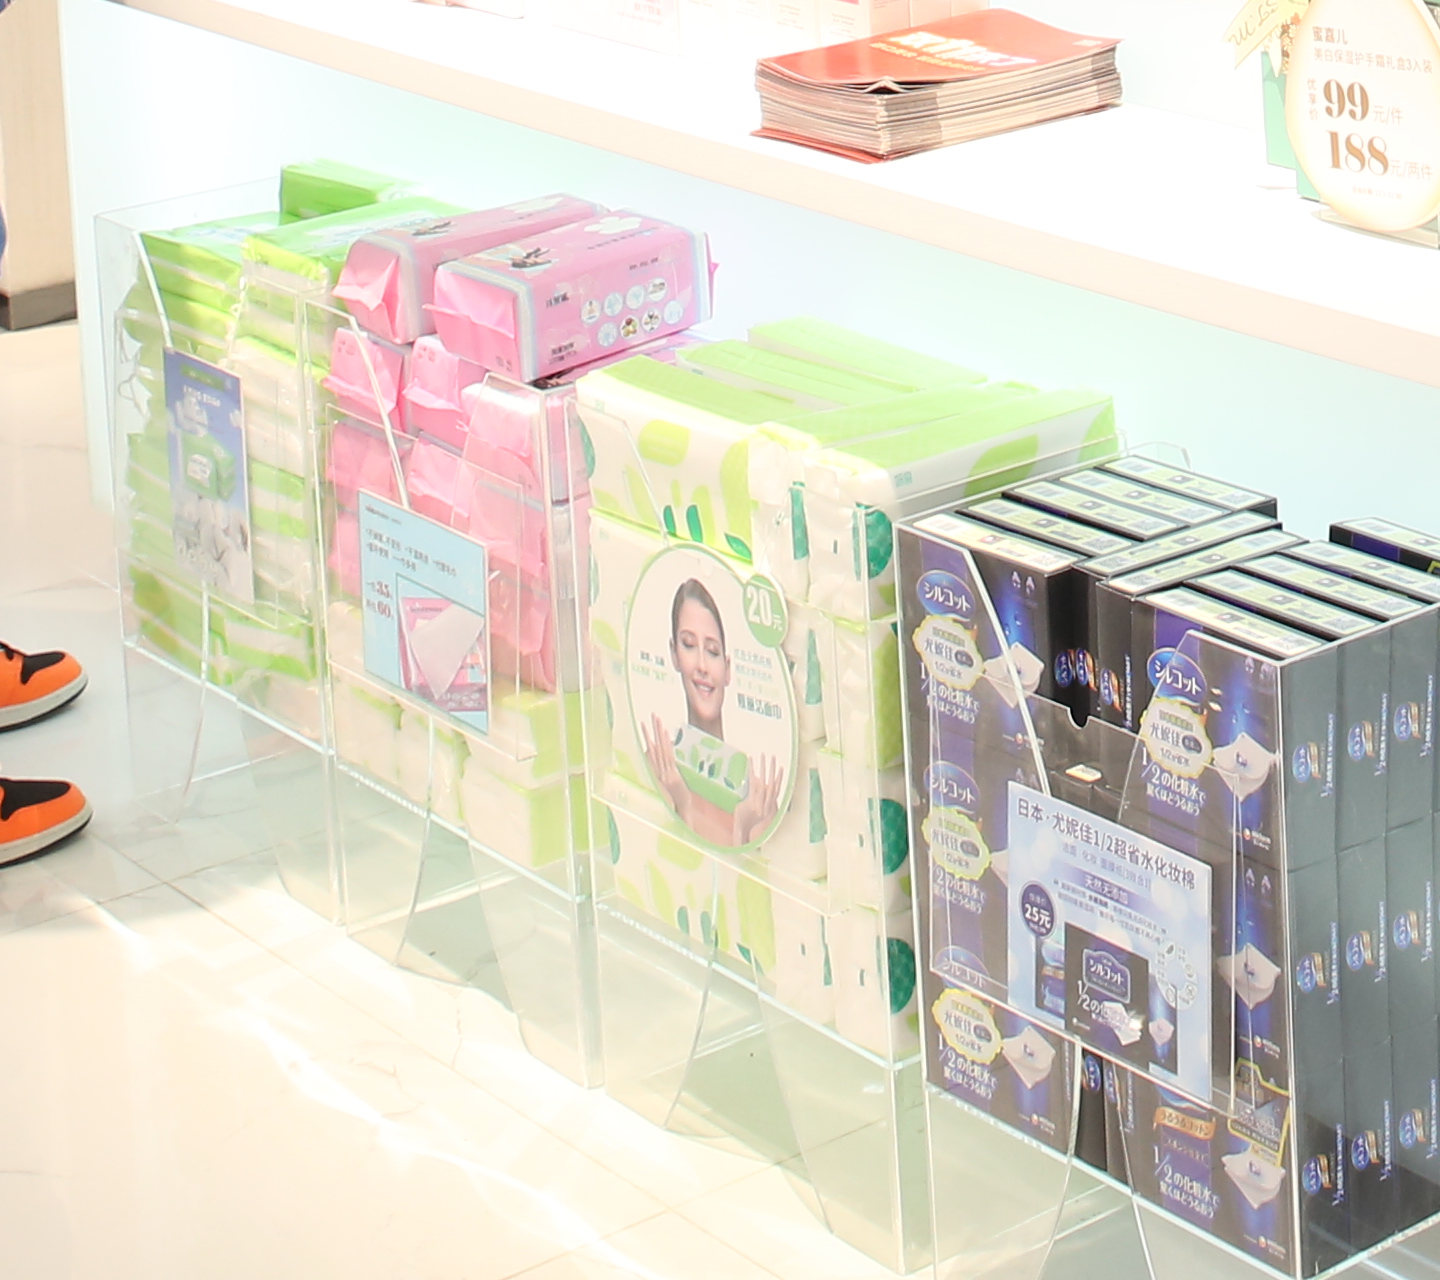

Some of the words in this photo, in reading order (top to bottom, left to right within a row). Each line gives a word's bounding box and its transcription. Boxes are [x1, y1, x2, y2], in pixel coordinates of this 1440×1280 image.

[1323, 78, 1370, 121] 99
[1325, 129, 1390, 176] 188
[924, 581, 972, 613] シルコット
[1153, 659, 1203, 697] シルコット
[931, 775, 976, 805] シルコット
[1024, 903, 1052, 928] 25元
